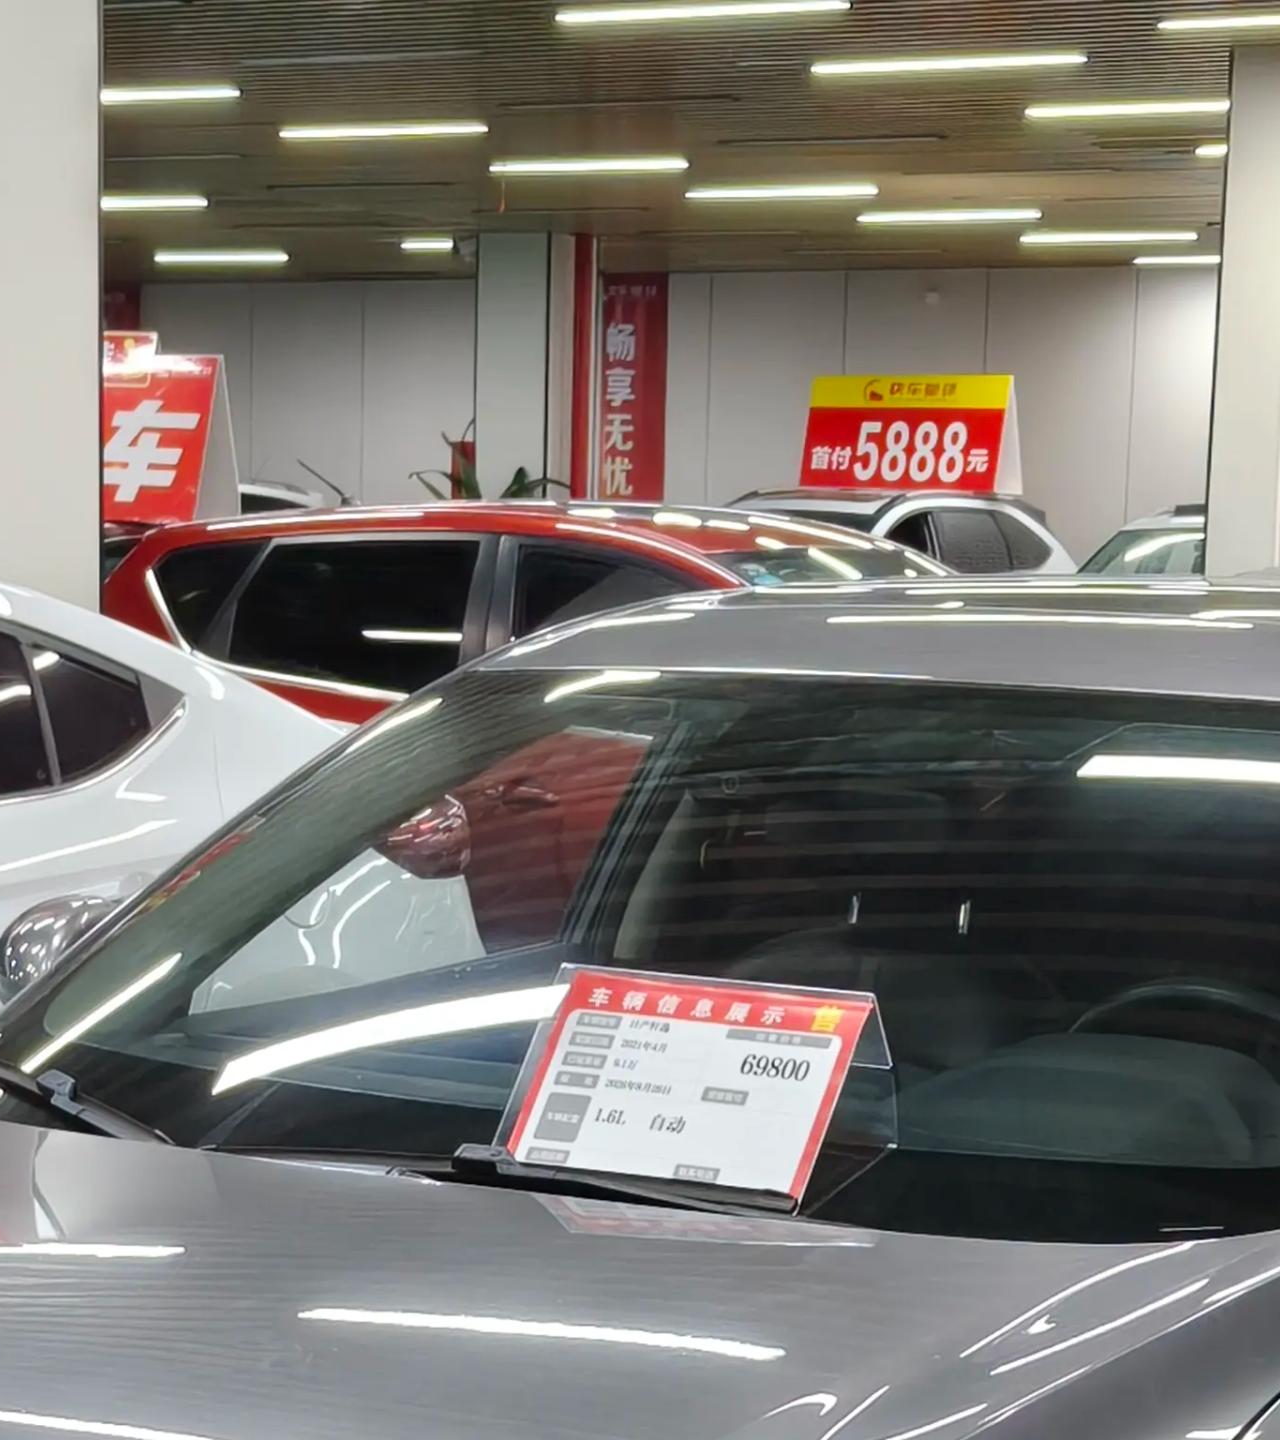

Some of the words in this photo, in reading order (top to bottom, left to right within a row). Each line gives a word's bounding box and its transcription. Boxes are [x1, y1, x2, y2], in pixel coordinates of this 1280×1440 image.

[604, 321, 637, 496] 畅享无忧
[810, 421, 989, 483] 首付5888元
[588, 987, 786, 1025] 车辆信息展示
[740, 1053, 811, 1082] 69800
[595, 1107, 626, 1126] 1.6L
[649, 1113, 687, 1135] 自动
